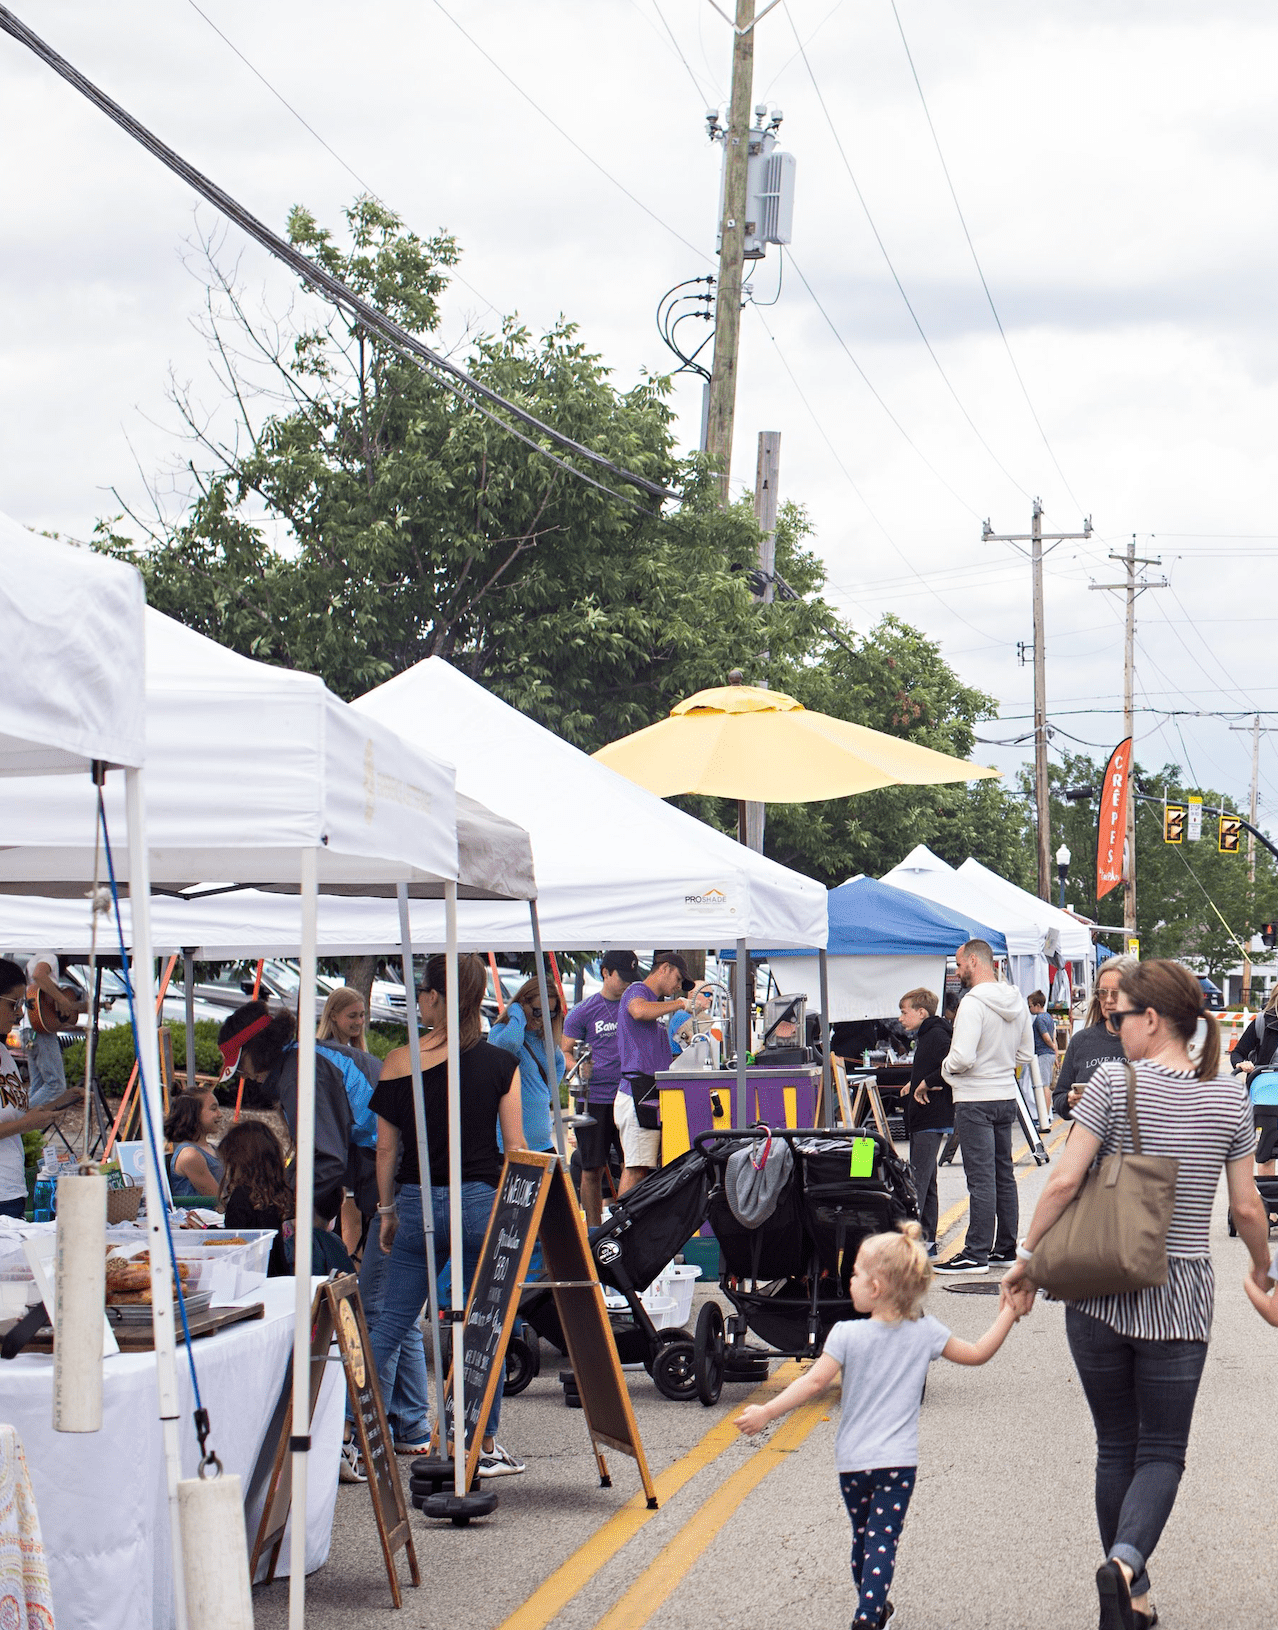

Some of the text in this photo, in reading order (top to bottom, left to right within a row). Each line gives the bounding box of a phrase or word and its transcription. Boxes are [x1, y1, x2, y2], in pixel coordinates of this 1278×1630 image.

[1108, 755, 1123, 863] CRÊPES
[684, 895, 727, 904] PROSHADE
[1086, 1056, 1110, 1069] LOVE
